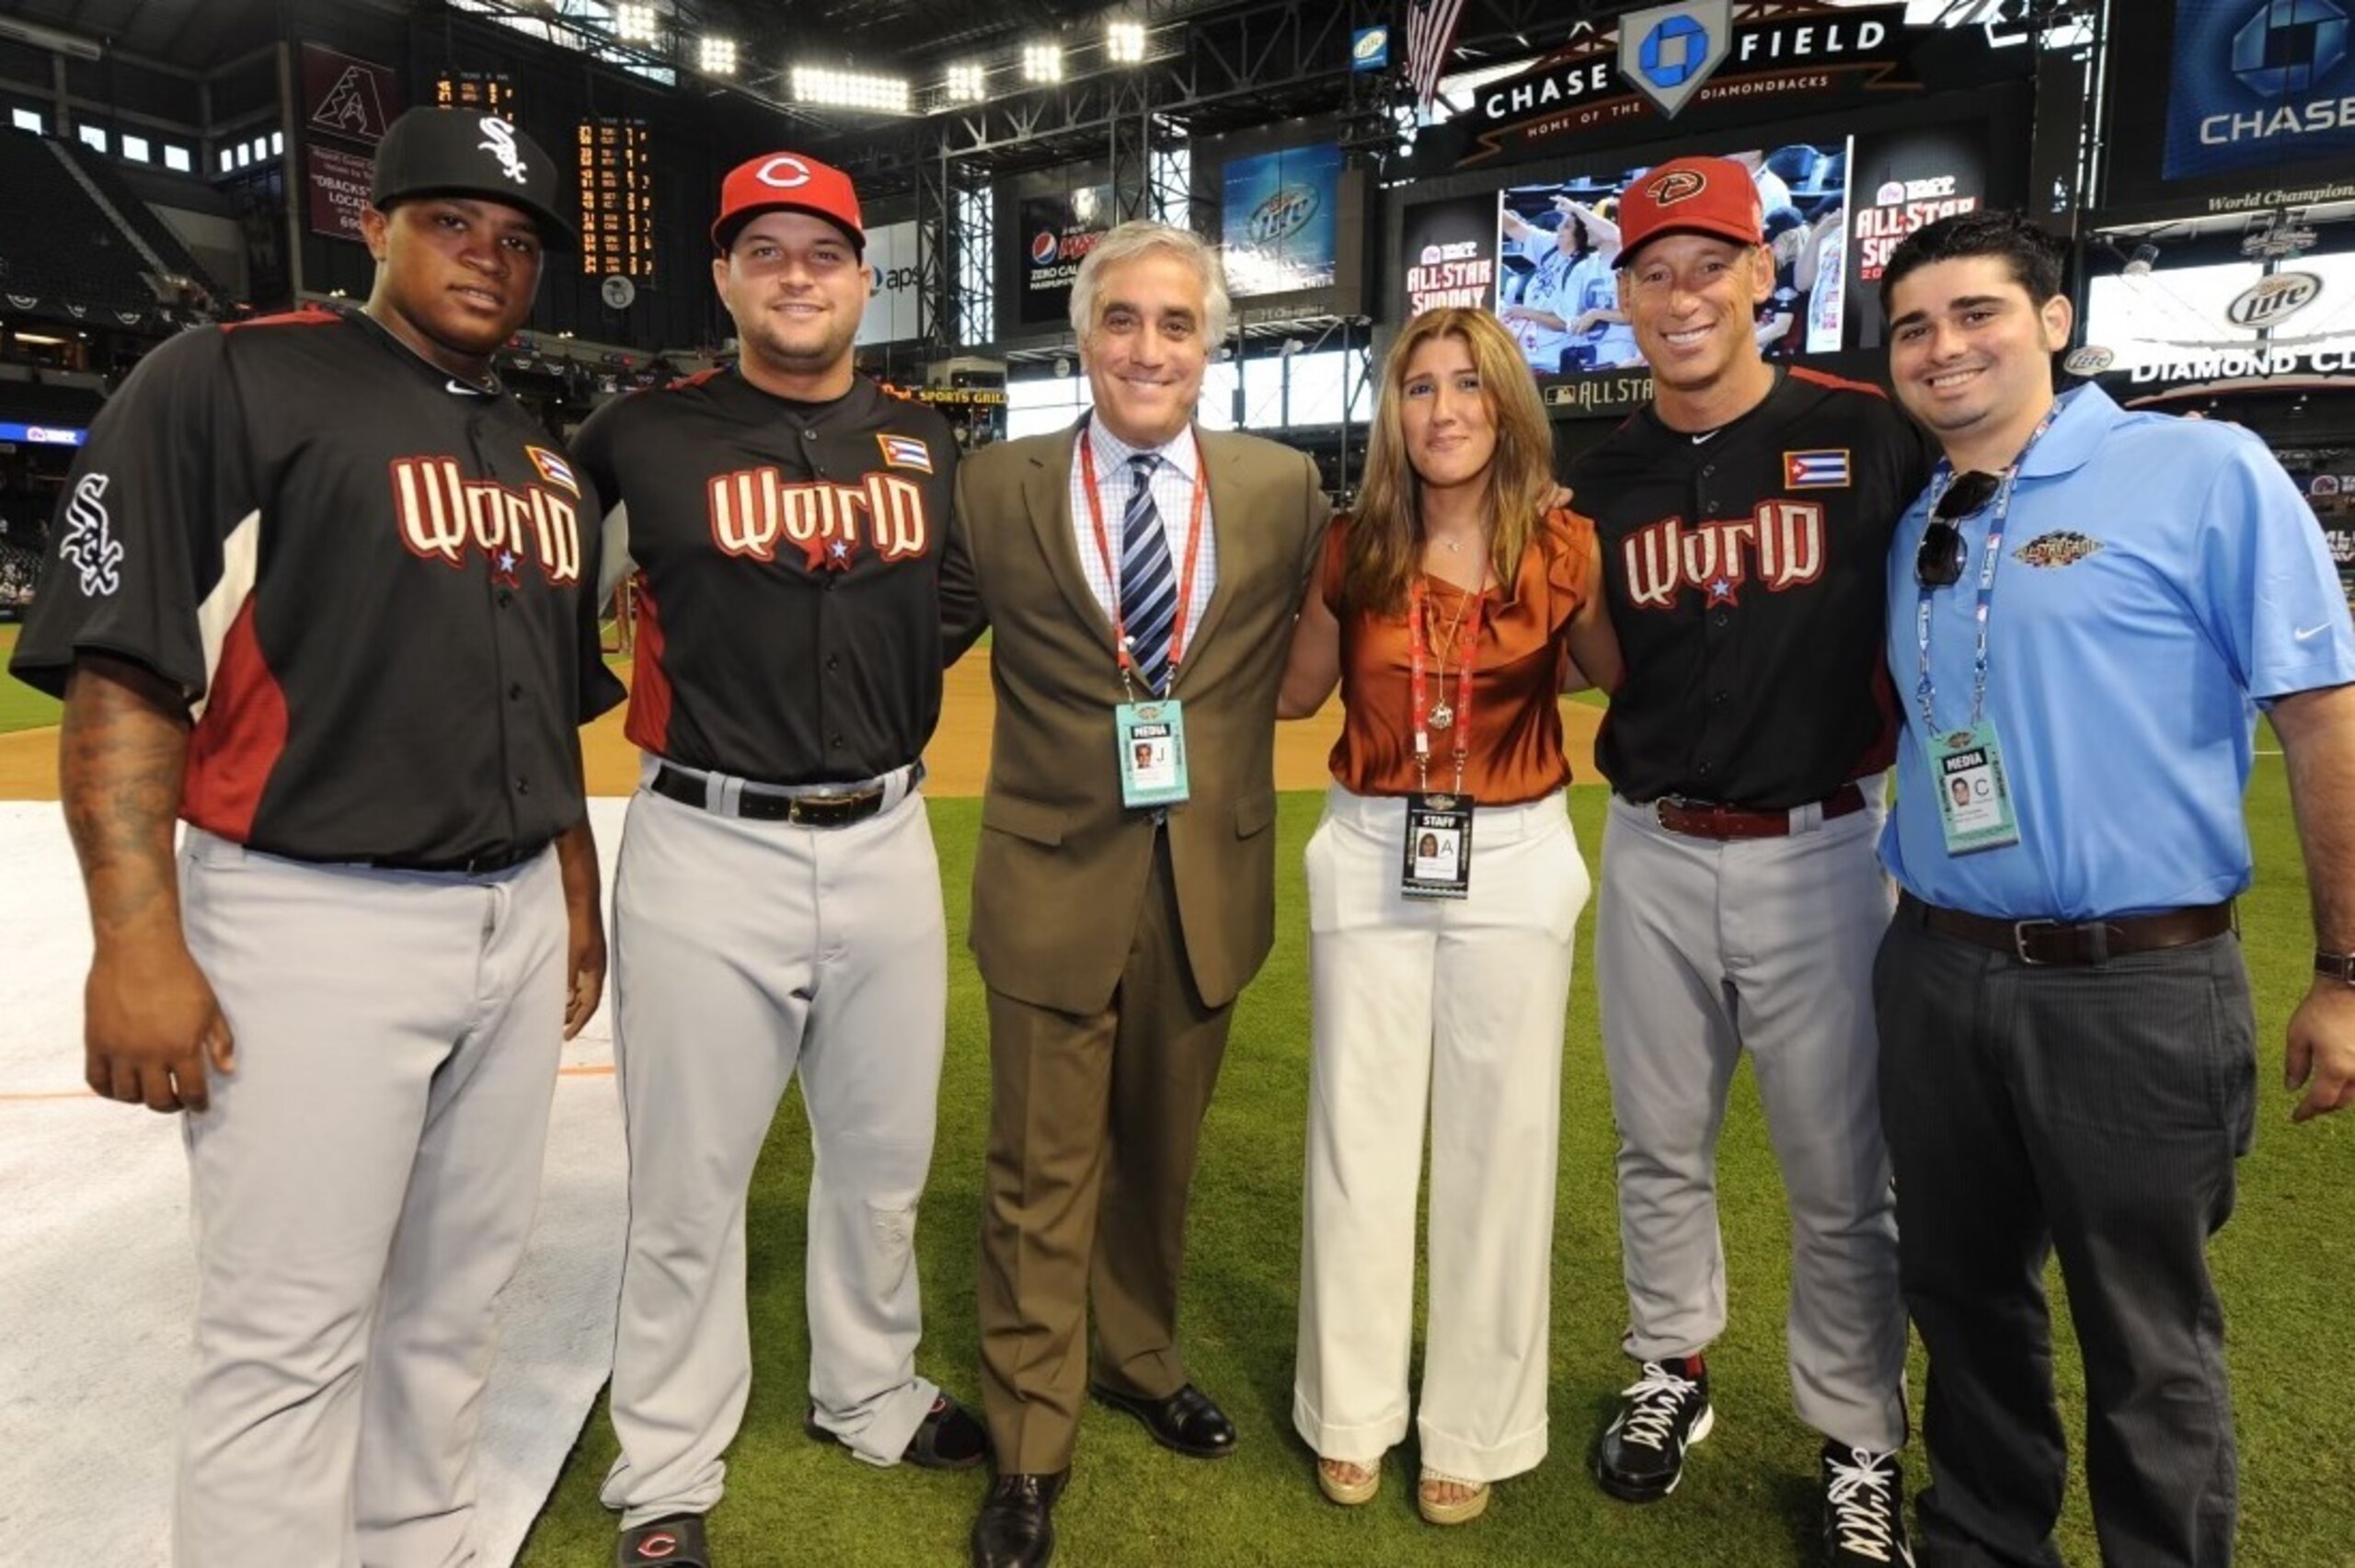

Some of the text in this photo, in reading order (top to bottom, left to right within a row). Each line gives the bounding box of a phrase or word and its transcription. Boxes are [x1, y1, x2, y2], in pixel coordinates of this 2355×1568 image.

[1486, 21, 1885, 119] CHASE FIELD
[1528, 75, 1829, 137] HOME OF THE DIAMONDBACKS
[2200, 96, 2355, 144] CHASE
[2209, 184, 2355, 211] World Champion
[886, 265, 919, 292] aps
[1031, 268, 1057, 280] ZERO
[1411, 287, 1487, 316] SUNDAY
[2244, 284, 2308, 322] Lite
[2131, 350, 2297, 383] DIAMOND
[920, 390, 970, 403] SPORTS
[1580, 381, 1614, 411] ALL
[1134, 725, 1167, 738] MEDIA
[1946, 751, 1983, 772] MEDIA
[1975, 779, 1989, 796] C
[1422, 816, 1455, 828] STAFF
[1441, 839, 1453, 854] A
